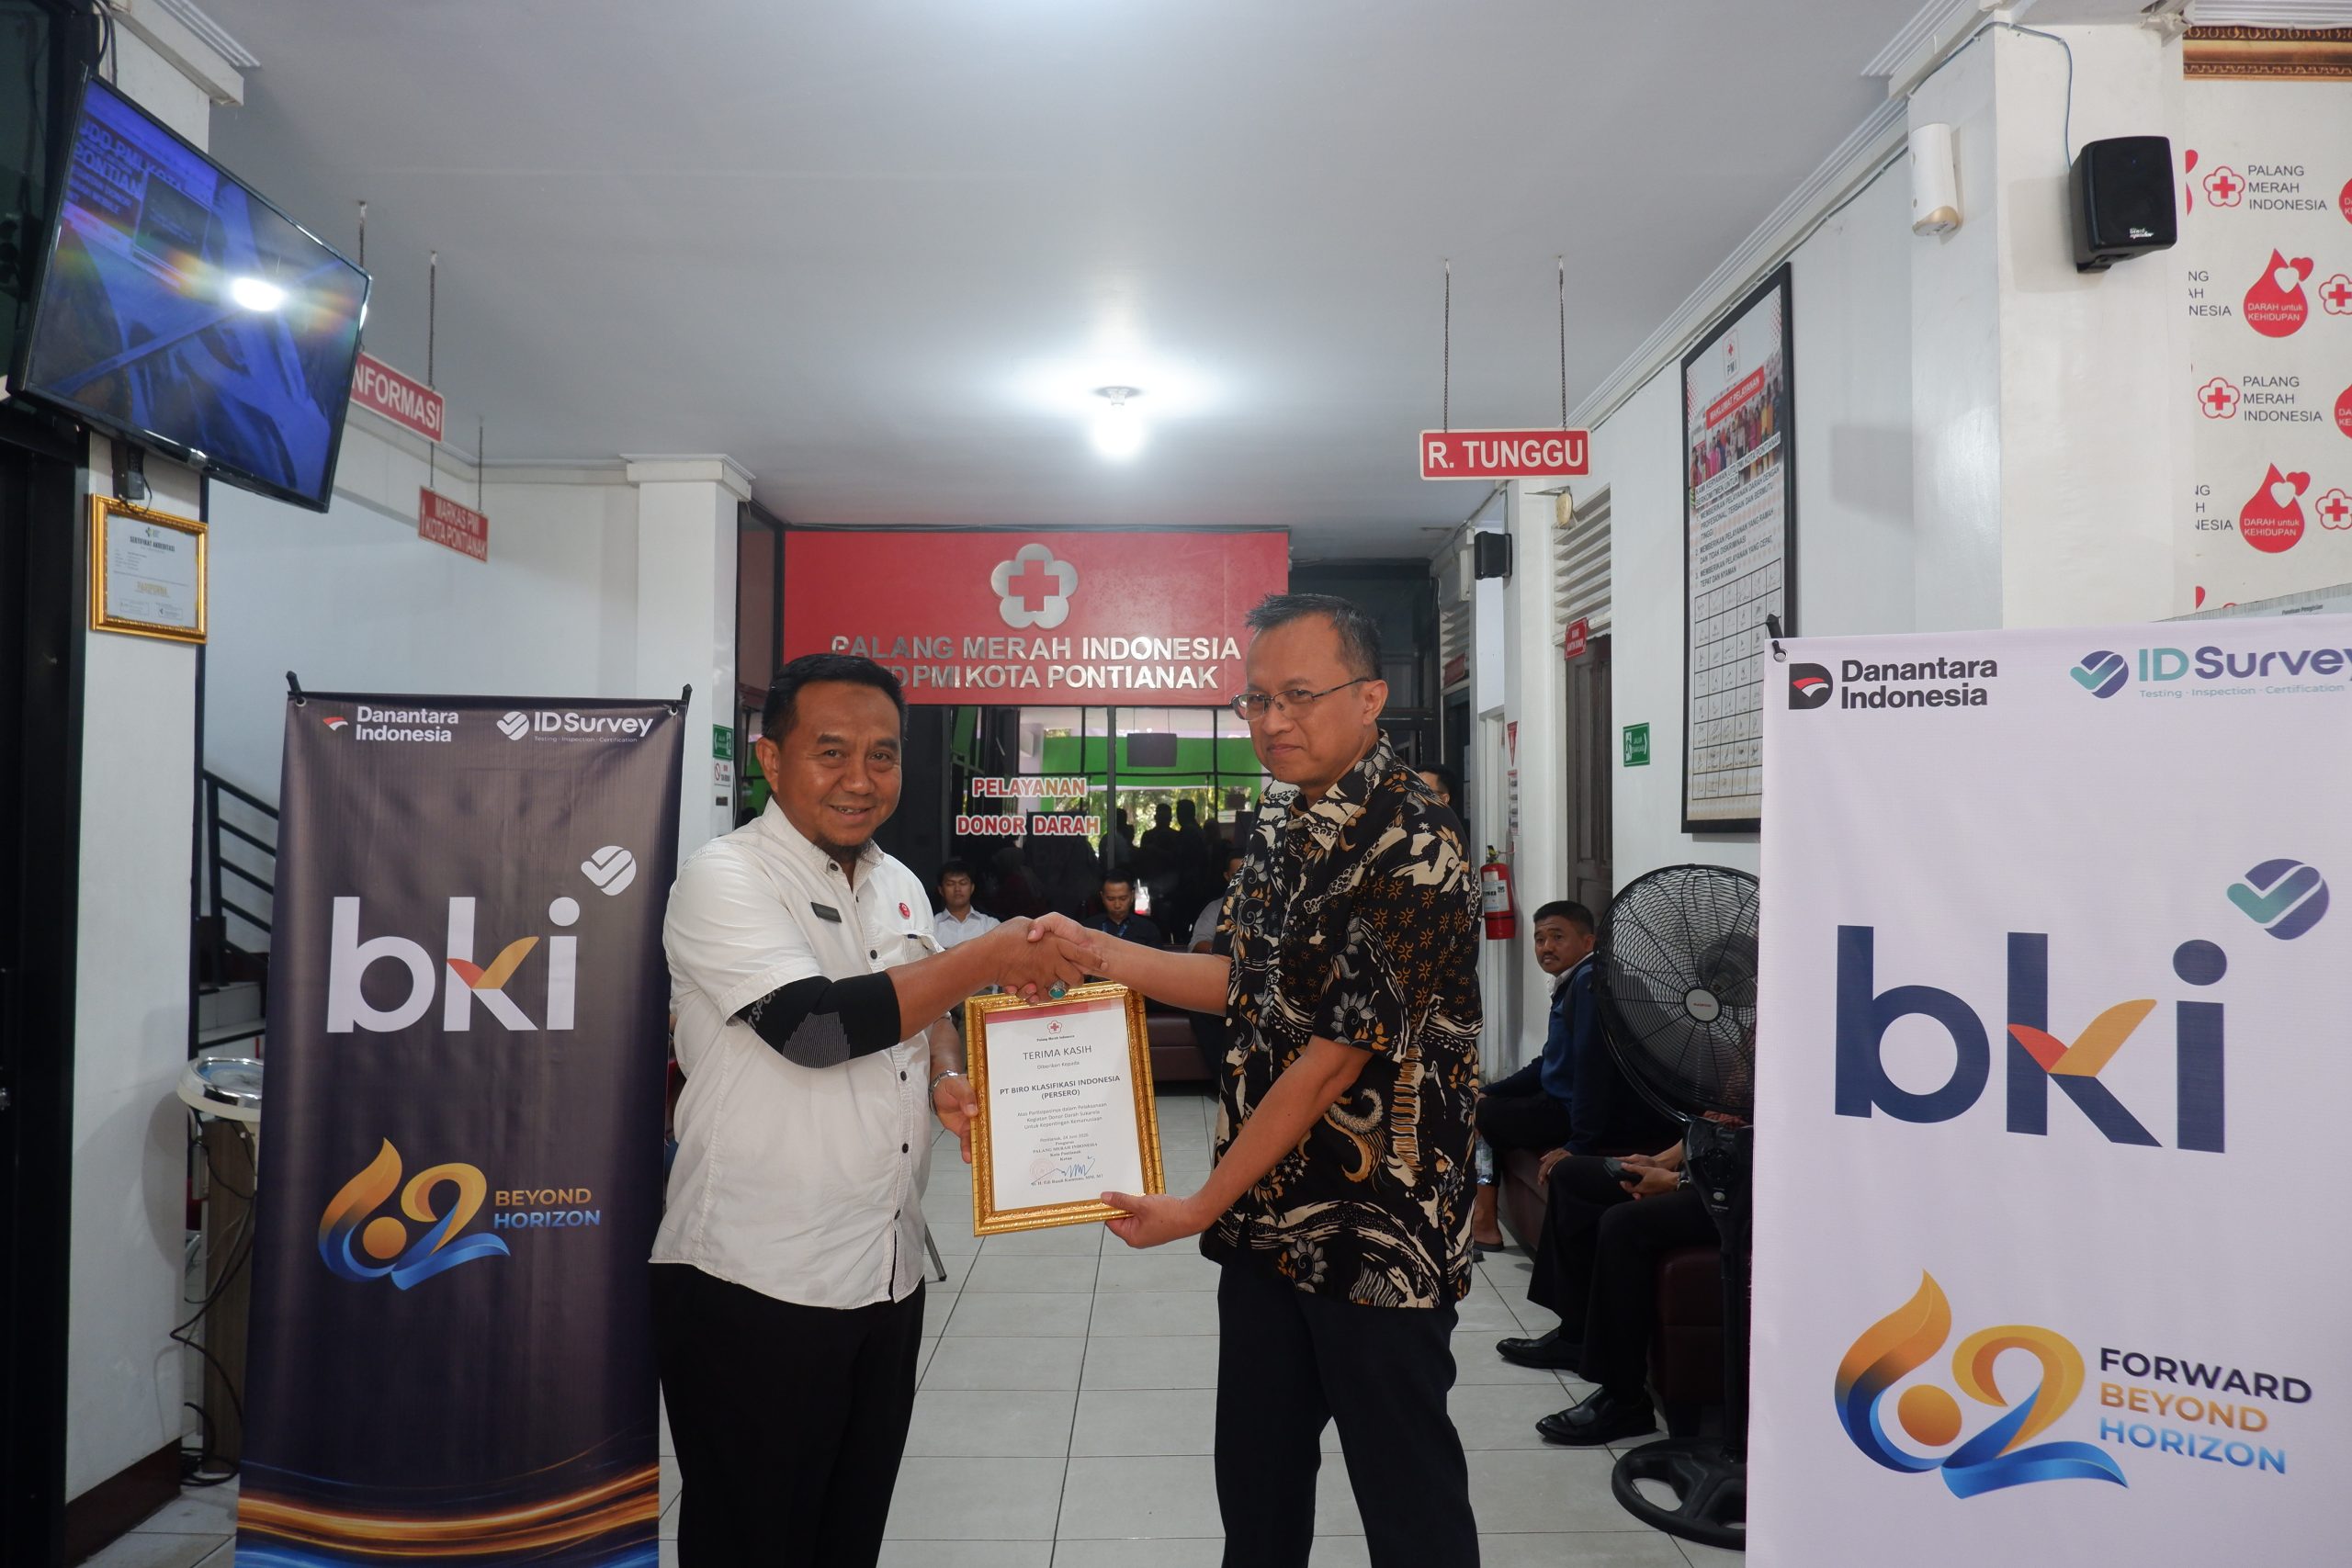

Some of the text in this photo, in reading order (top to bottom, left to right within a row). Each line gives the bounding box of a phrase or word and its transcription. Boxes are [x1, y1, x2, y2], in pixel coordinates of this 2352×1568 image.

[2248, 165, 2304, 176] PALANG
[2248, 182, 2300, 193] MERAH
[2249, 198, 2327, 210] INDONESIA
[2188, 305, 2232, 317] NESIA
[2247, 302, 2303, 311] DARAH untuk
[2247, 313, 2300, 321] KEHIDUPAN
[2243, 376, 2300, 388] PALANG
[352, 364, 441, 432] NFORMASI
[2244, 393, 2294, 404] MERAH
[2244, 411, 2323, 422] INDONESIA
[1428, 439, 1583, 468] R. TUNGGU
[2244, 518, 2300, 526] DARAH untuk
[2244, 528, 2296, 536] KEHIDUPAN
[831, 636, 1241, 660] PALANG MERAH INDONESIA
[912, 666, 961, 689] PMI
[965, 665, 1041, 689] KOTA
[1047, 665, 1218, 689] PONTIANAK
[1841, 657, 1997, 682] Danantara
[1841, 682, 1988, 709] Indonesia
[2140, 683, 2346, 699] Testing Inspection Certification
[356, 705, 458, 725] Danantara
[356, 724, 452, 742] Indonesia
[972, 777, 1088, 797] PELAYANAN
[956, 815, 1101, 835] DONOR DARAH
[326, 896, 581, 1032] bki
[1835, 924, 2228, 1154] bki
[1023, 1044, 1091, 1060] TERIMA KASIH
[1011, 1085, 1030, 1094] BIRO
[1031, 1080, 1076, 1091] KLASIFIKASI
[1078, 1075, 1121, 1087] INDONESIA
[1041, 1089, 1080, 1100] (PERSERO)
[495, 1188, 593, 1206] BEYOND
[493, 1210, 601, 1229] HORIZON
[2100, 1347, 2312, 1404] FORWARD
[2100, 1382, 2268, 1432] BEYOND
[2099, 1416, 2286, 1474] HORIZON
